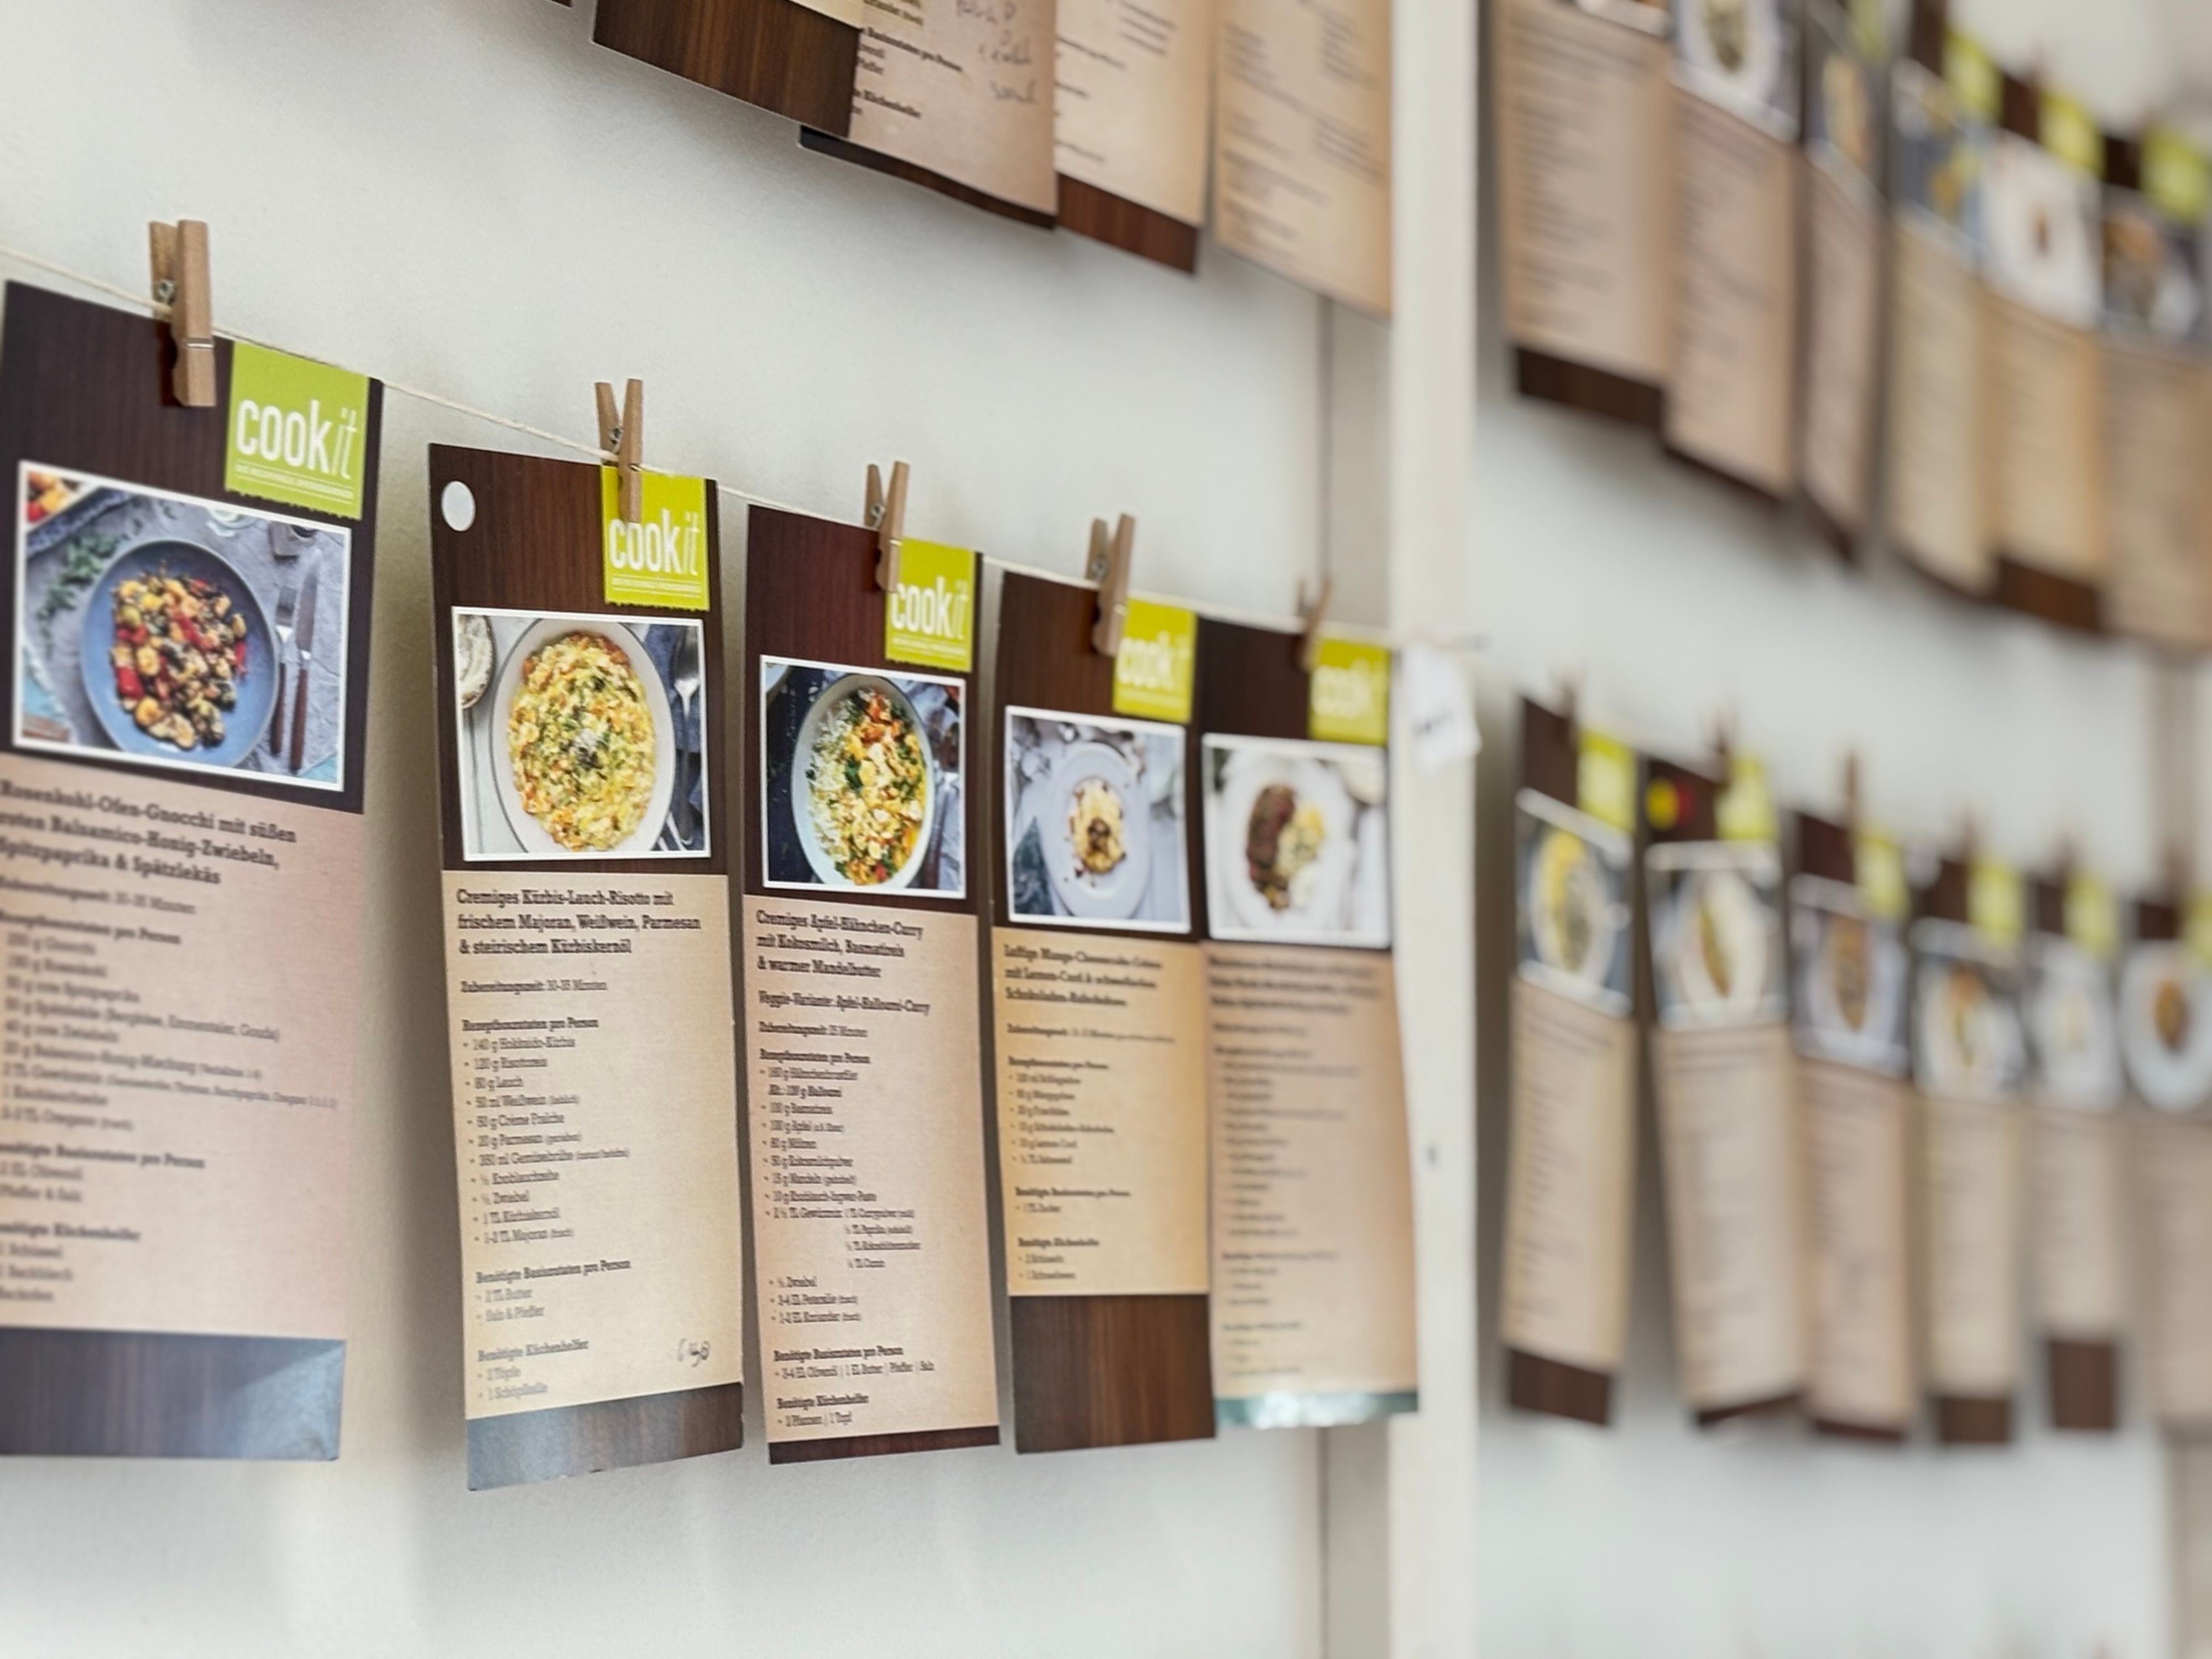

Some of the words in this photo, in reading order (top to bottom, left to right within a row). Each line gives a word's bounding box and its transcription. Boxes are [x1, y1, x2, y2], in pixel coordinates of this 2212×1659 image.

[218, 817, 246, 834] mit
[249, 822, 297, 843] süßen
[115, 853, 127, 870] &
[133, 855, 221, 884] Spätzlekäs
[457, 889, 519, 909] Cremiges
[521, 889, 650, 905] Kürbis-Lauch-Risotto
[653, 890, 674, 905] mit
[458, 914, 516, 929] frischem
[518, 914, 576, 933] Majoran,
[576, 914, 640, 932] Weißwein,
[641, 914, 701, 930] Parmesan
[757, 910, 808, 931] Cremiges
[460, 939, 470, 954] &
[473, 938, 548, 954] steirischem
[550, 938, 632, 953] Kürbiskernöl
[756, 933, 775, 947] mit
[757, 956, 766, 970] &
[768, 960, 811, 973] warmer
[567, 1016, 599, 1028] Person
[600, 1260, 632, 1272] Person
